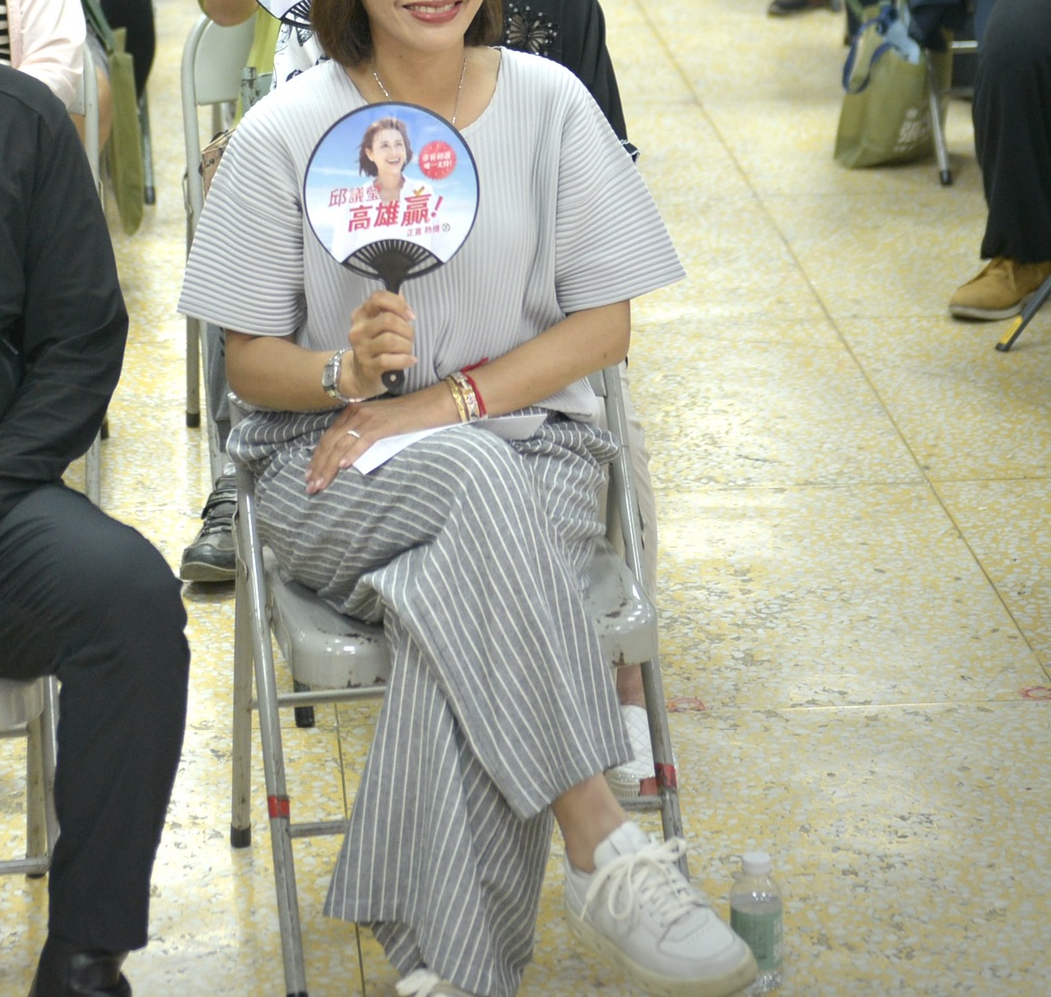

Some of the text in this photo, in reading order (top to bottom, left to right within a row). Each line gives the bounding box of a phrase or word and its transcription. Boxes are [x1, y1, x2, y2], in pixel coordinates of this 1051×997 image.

[328, 185, 381, 207] 邱議瑩
[348, 193, 443, 233] 高雄贏!
